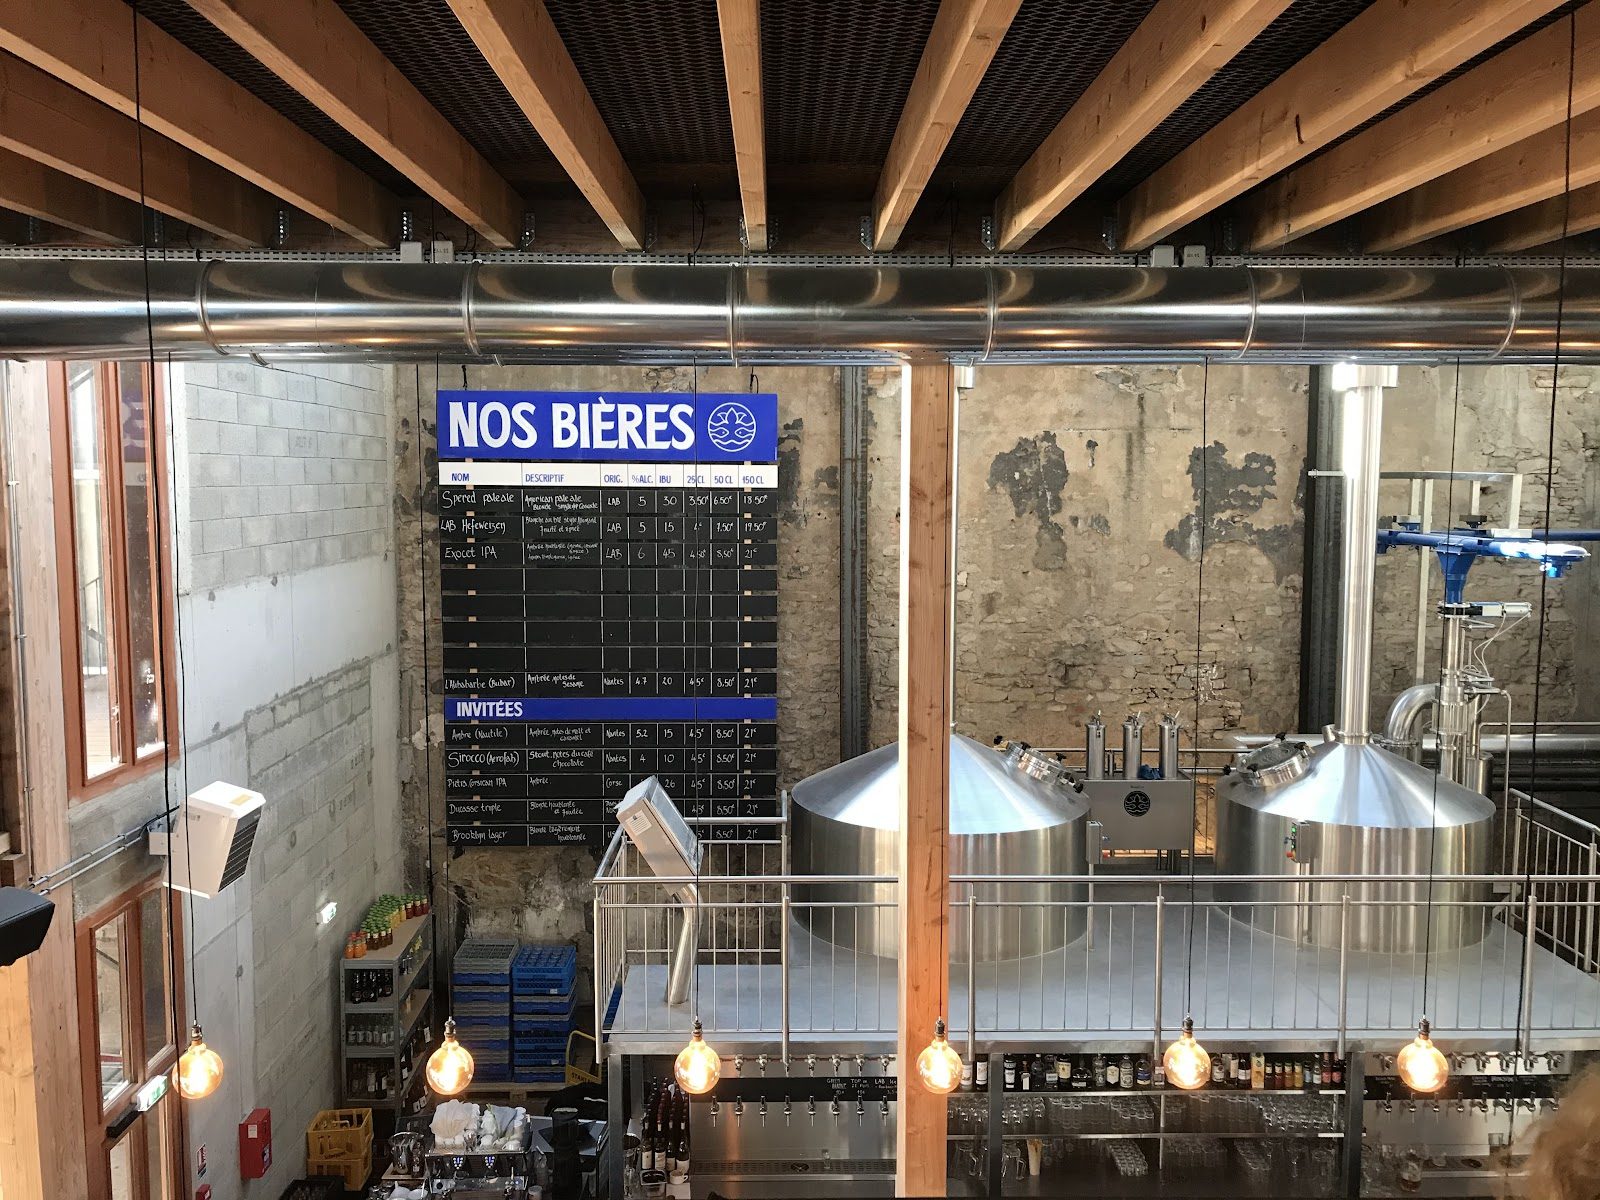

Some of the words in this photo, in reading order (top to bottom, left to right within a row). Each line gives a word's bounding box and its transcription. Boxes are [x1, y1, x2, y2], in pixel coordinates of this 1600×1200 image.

[449, 402, 538, 449] NOS
[552, 397, 694, 450] BIÈRES
[451, 473, 470, 482] NOM
[525, 473, 564, 483] DESCRIPTIF
[604, 474, 623, 484] ORIG.
[659, 474, 671, 484] IBU
[687, 475, 696, 484] 25
[697, 475, 705, 484] CL
[714, 475, 724, 484] 50
[725, 475, 733, 484] CL
[742, 475, 755, 484] 150
[756, 475, 764, 484] CL
[442, 490, 476, 508] Spered
[525, 495, 553, 507] American
[555, 494, 569, 506] pale
[570, 494, 582, 502] ale
[608, 497, 620, 506] LAB
[638, 496, 647, 506] 5
[663, 496, 677, 506] 30
[440, 520, 456, 533] LAB
[462, 518, 506, 535] Hefeweizen
[607, 522, 621, 533] LAB
[638, 521, 647, 533] 5
[664, 521, 675, 532] 15
[445, 546, 476, 560] Exocet
[481, 546, 497, 559] IPA
[605, 547, 622, 560] LAB
[637, 547, 645, 559] 6
[662, 548, 676, 559] 45
[662, 676, 673, 686] 20
[456, 699, 523, 717] INVITÉES
[664, 728, 673, 739] 15
[448, 751, 485, 768] Sirocco
[639, 753, 646, 763] 4
[664, 754, 675, 763] 10
[495, 777, 508, 787] IPA
[606, 777, 622, 788] Corse
[664, 778, 676, 788] 26
[448, 803, 479, 814] Ducasse
[480, 802, 502, 814] triple
[488, 828, 508, 843] lager
